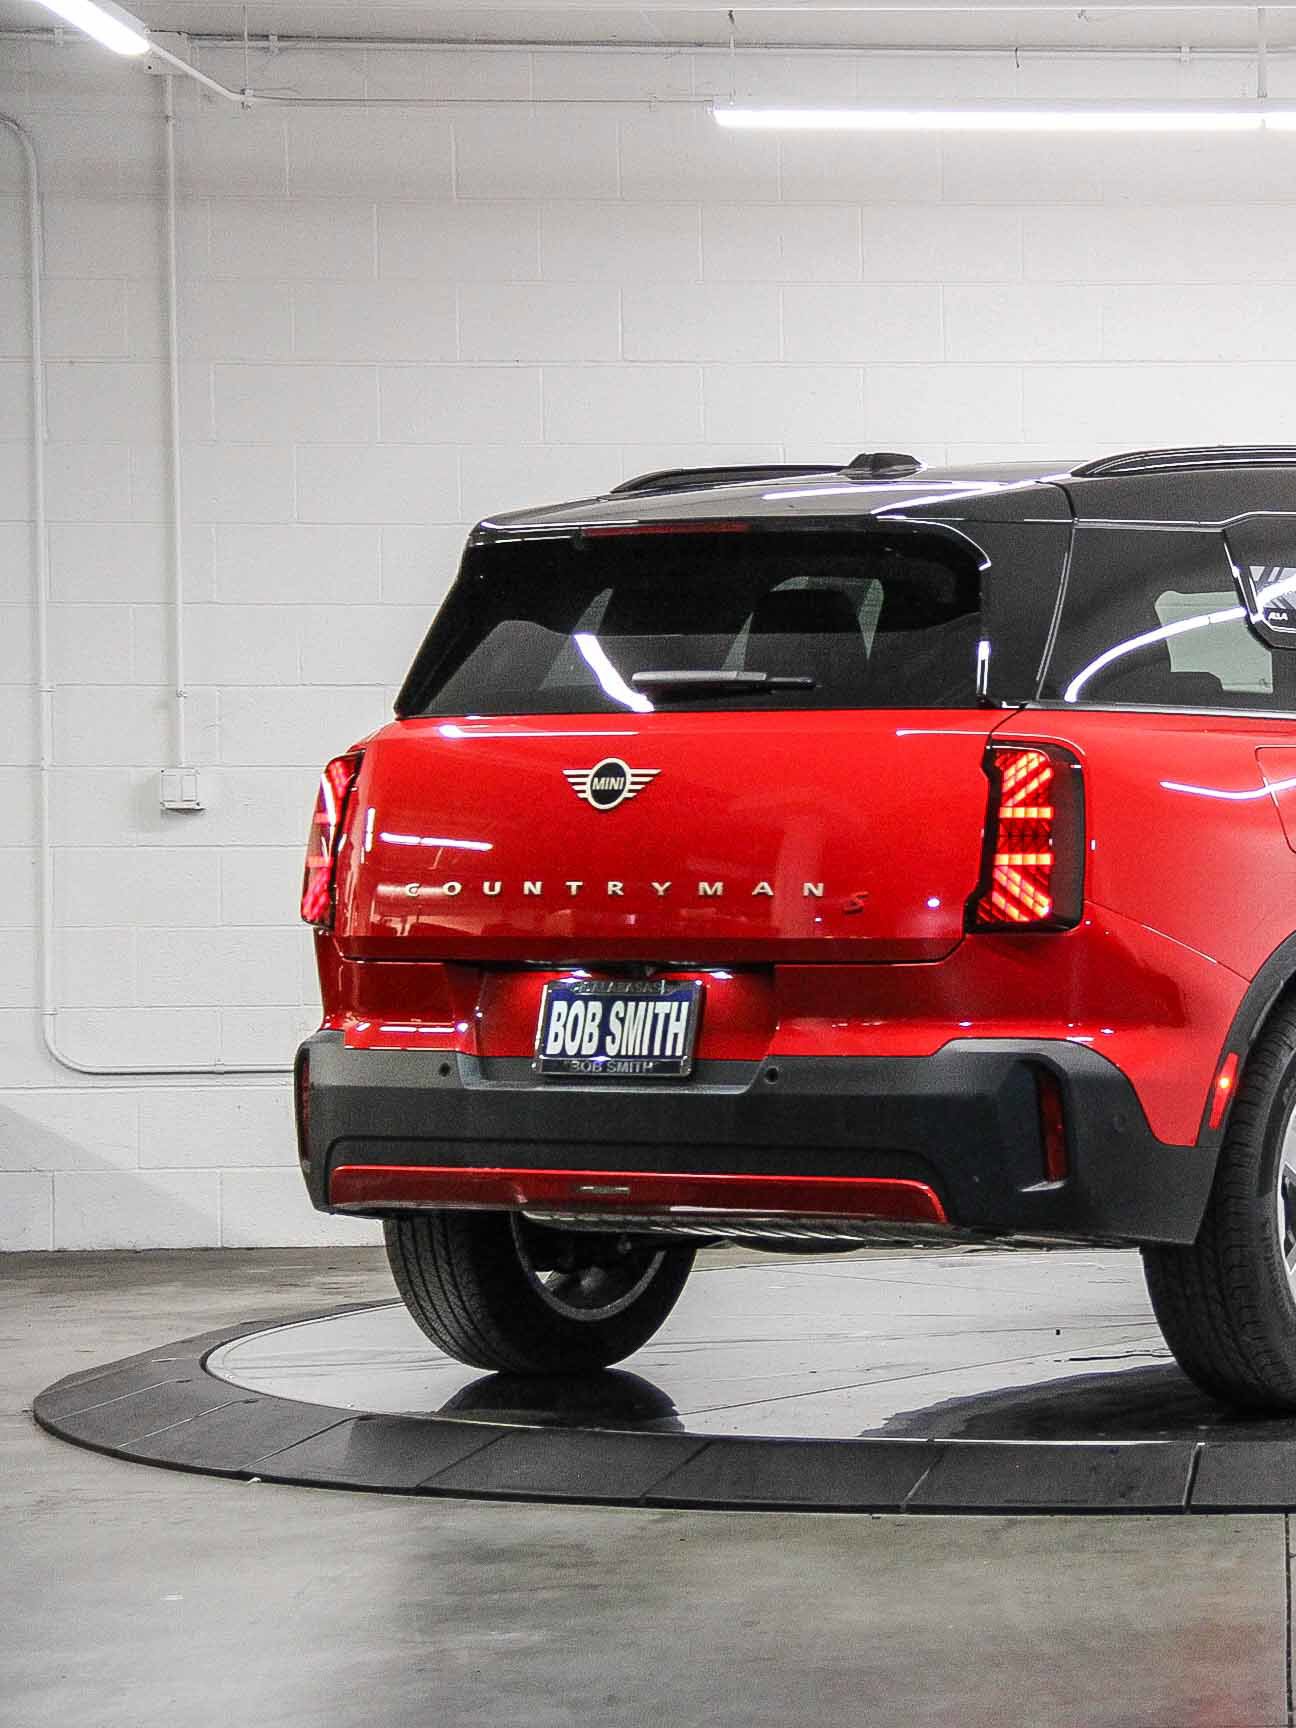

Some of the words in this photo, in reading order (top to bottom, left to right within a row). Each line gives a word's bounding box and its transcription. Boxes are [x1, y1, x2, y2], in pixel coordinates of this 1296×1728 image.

[591, 777, 625, 790] MINI
[404, 881, 826, 898] COUNTRYMAN
[545, 1000, 602, 1055] BOB
[605, 1001, 690, 1057] SMITH
